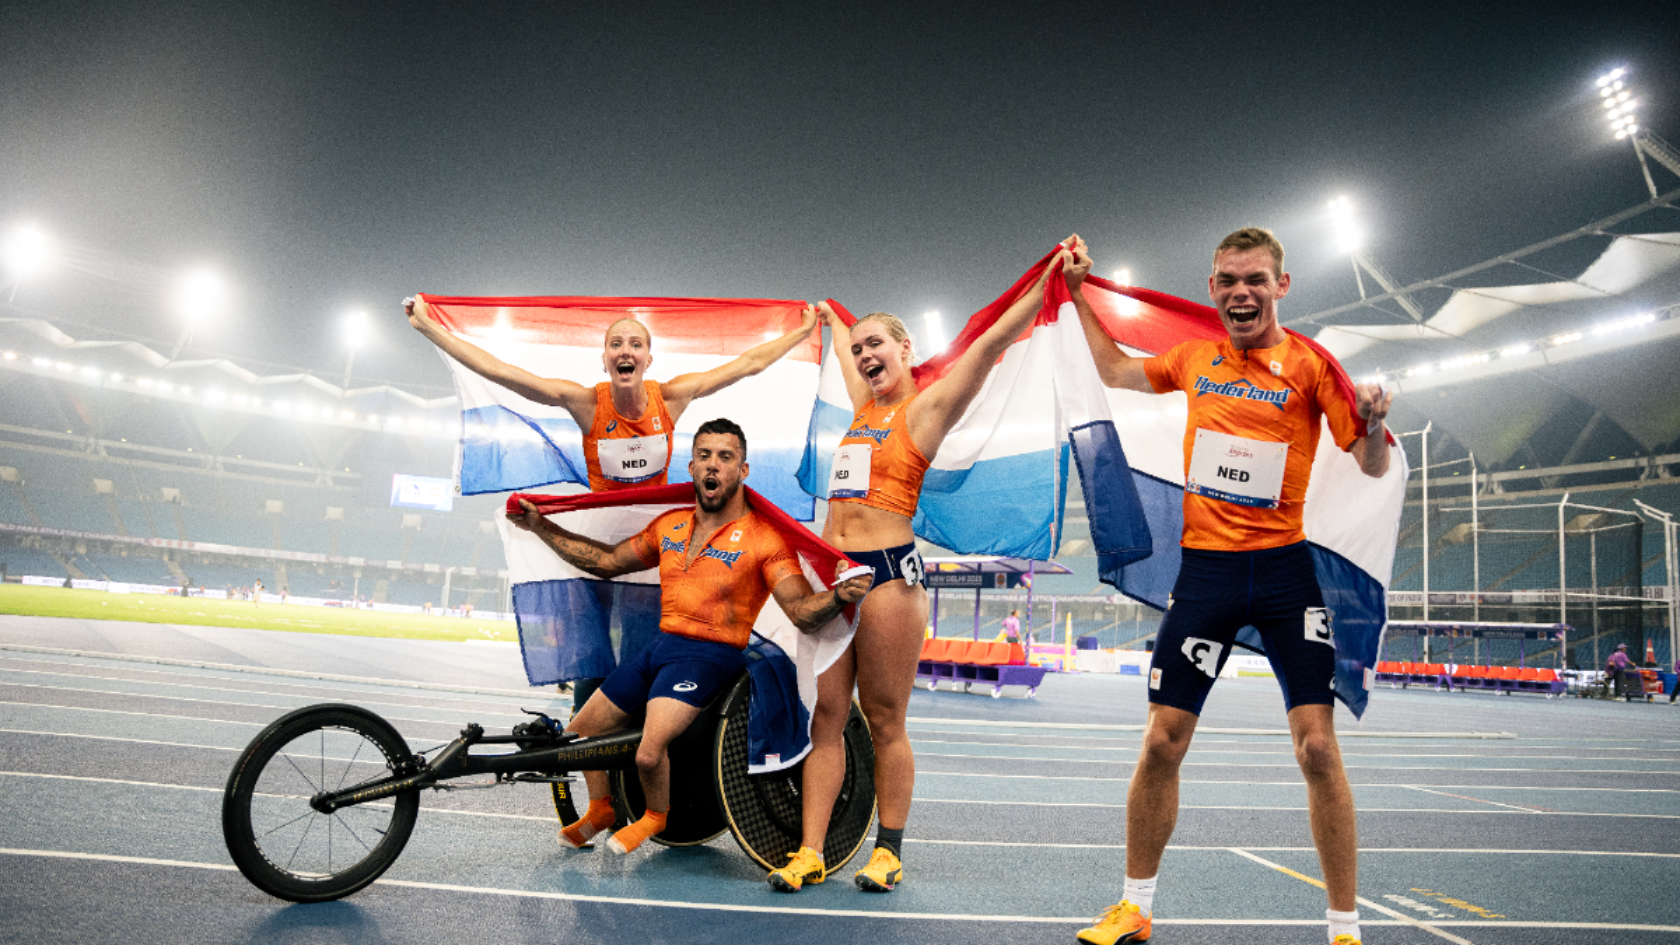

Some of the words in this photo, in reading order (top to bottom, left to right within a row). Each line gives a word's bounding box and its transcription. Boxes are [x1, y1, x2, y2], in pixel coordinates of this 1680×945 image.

[1193, 375, 1292, 405] Nederland
[622, 459, 647, 469] NED
[1217, 465, 1250, 482] NED
[906, 556, 918, 585] 3
[929, 575, 945, 583] NEW
[946, 575, 966, 583] DELHI
[967, 575, 982, 583] 2025
[1316, 608, 1331, 640] 3
